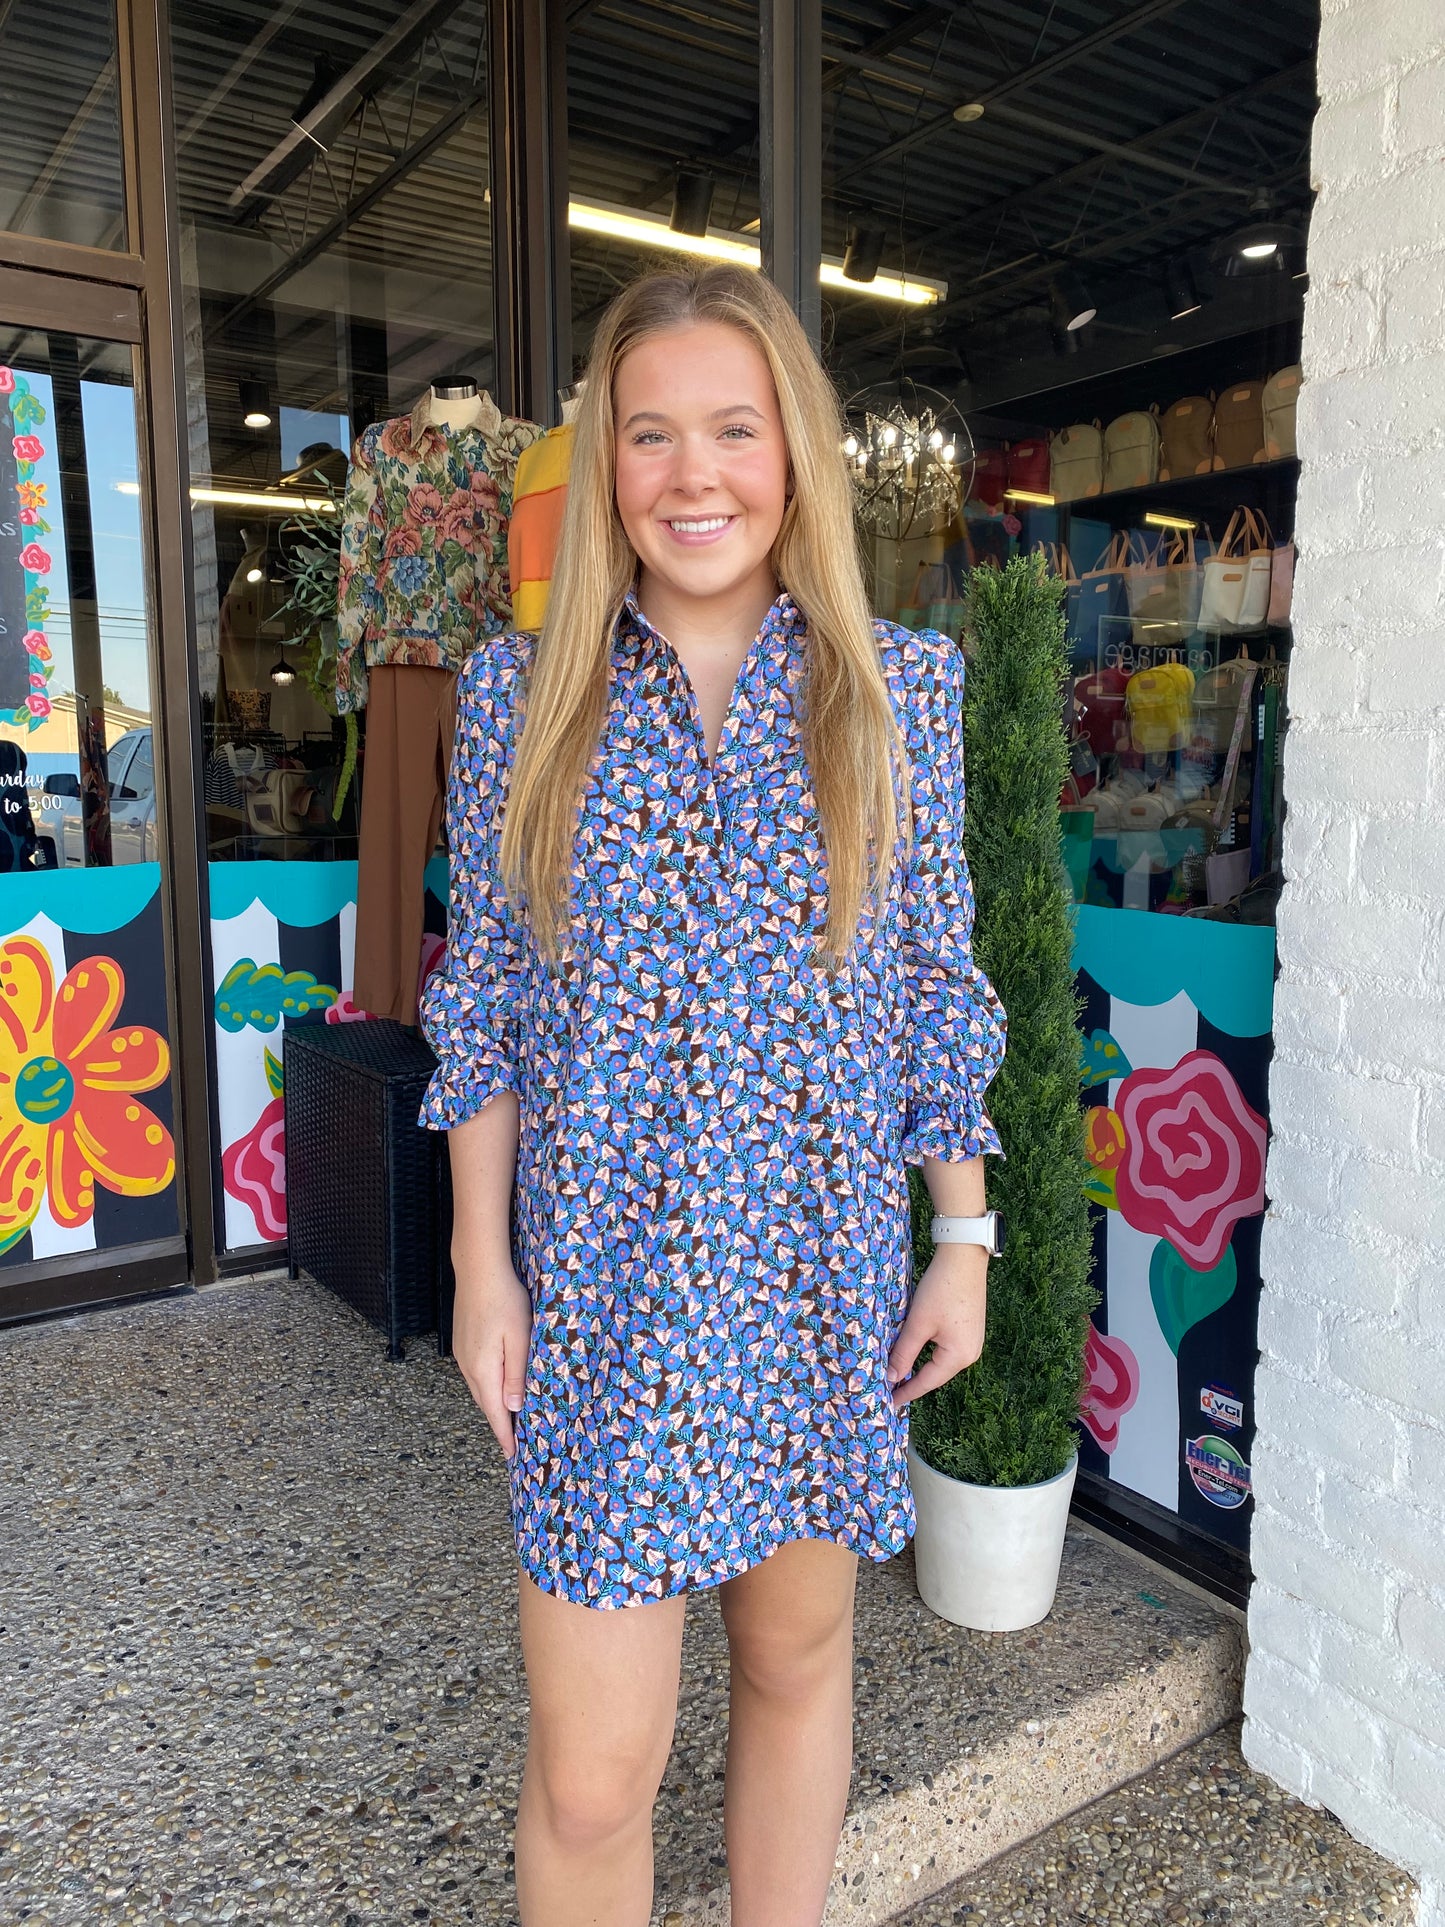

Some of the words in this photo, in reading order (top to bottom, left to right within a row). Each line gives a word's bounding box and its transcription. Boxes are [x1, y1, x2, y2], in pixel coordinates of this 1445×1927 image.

[4, 797, 22, 815] to
[1214, 1399, 1241, 1419] VGI
[1187, 1440, 1252, 1484] Ener-Tel
[1197, 1469, 1239, 1494] Ener-Tel.com
